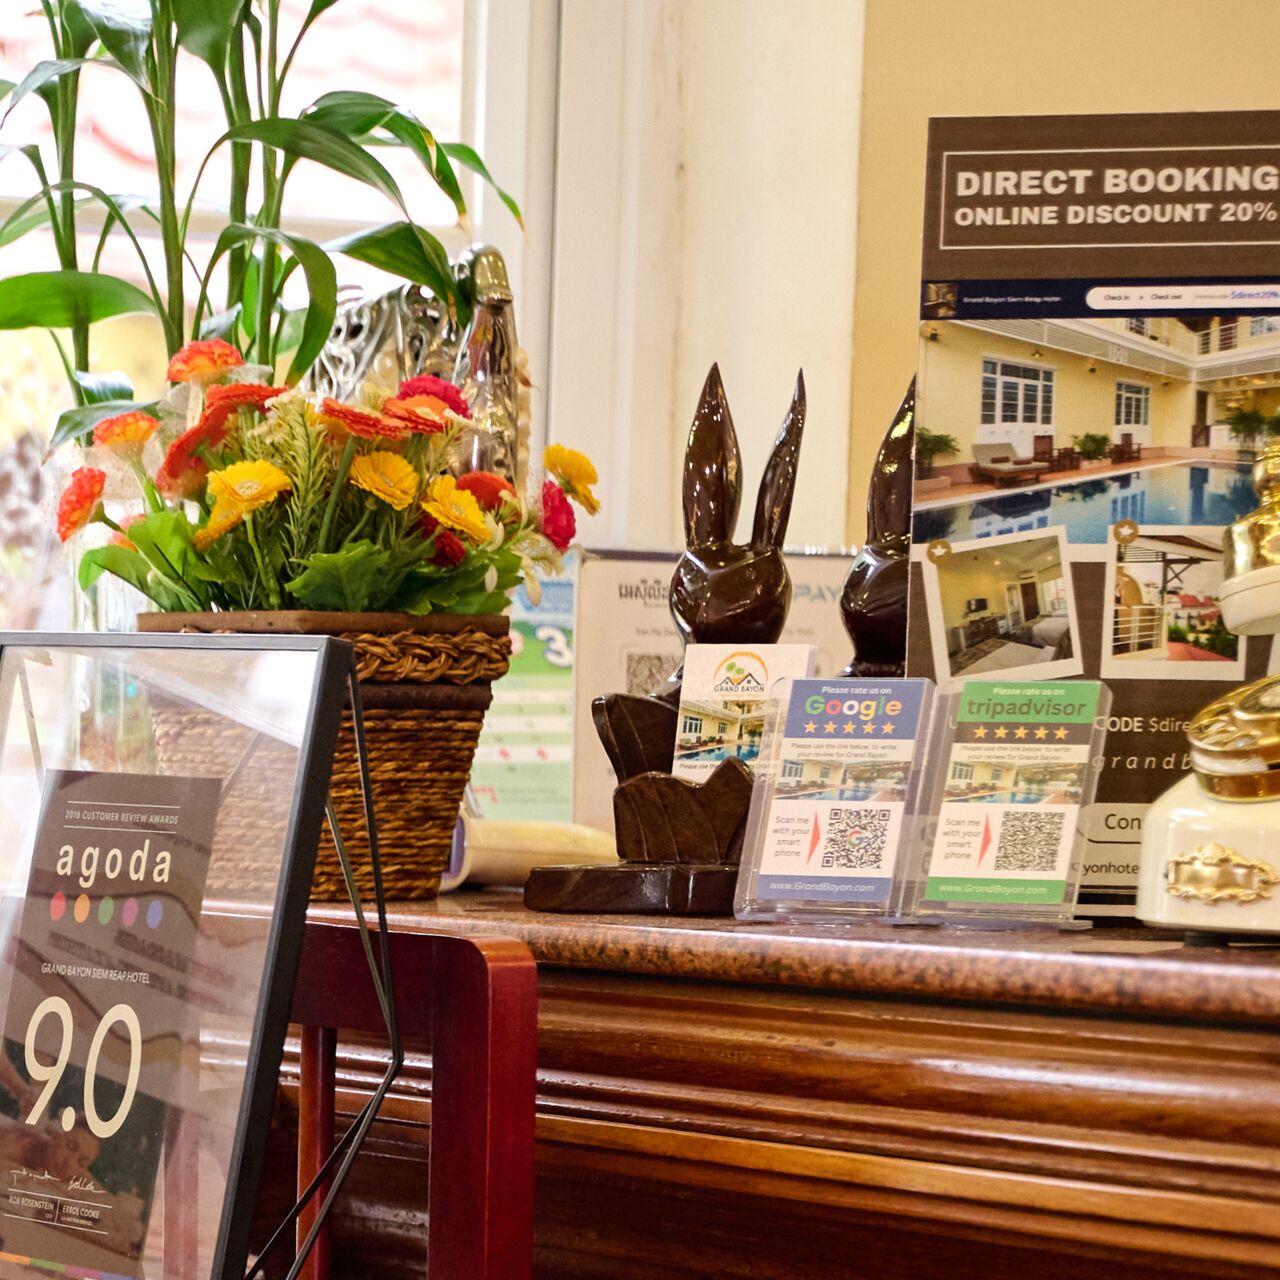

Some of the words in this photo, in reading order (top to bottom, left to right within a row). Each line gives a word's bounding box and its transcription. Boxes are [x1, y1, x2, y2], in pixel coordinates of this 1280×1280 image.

[957, 169, 1093, 196] DIRECT
[1104, 165, 1279, 193] BOOKING
[955, 206, 1059, 226] ONLINE
[1067, 203, 1213, 225] DISCOUNT
[1220, 201, 1278, 221] 20%
[821, 686, 848, 694] Please
[850, 686, 866, 694] rate
[805, 695, 902, 720] Google
[967, 698, 1087, 719] tripadvisor
[65, 810, 81, 819] 2016
[82, 811, 119, 821] CUSTOMER
[121, 813, 147, 823] REVIEW
[148, 815, 179, 824] AWARDS
[56, 839, 172, 888] agoda
[770, 881, 875, 892] www.GrandBayon.com
[41, 962, 66, 975] GRAND
[66, 965, 92, 977] BAYON
[92, 968, 109, 979] SIEM
[109, 969, 127, 981] REAP
[128, 971, 151, 984] HOTEL
[24, 996, 142, 1138] 9.0
